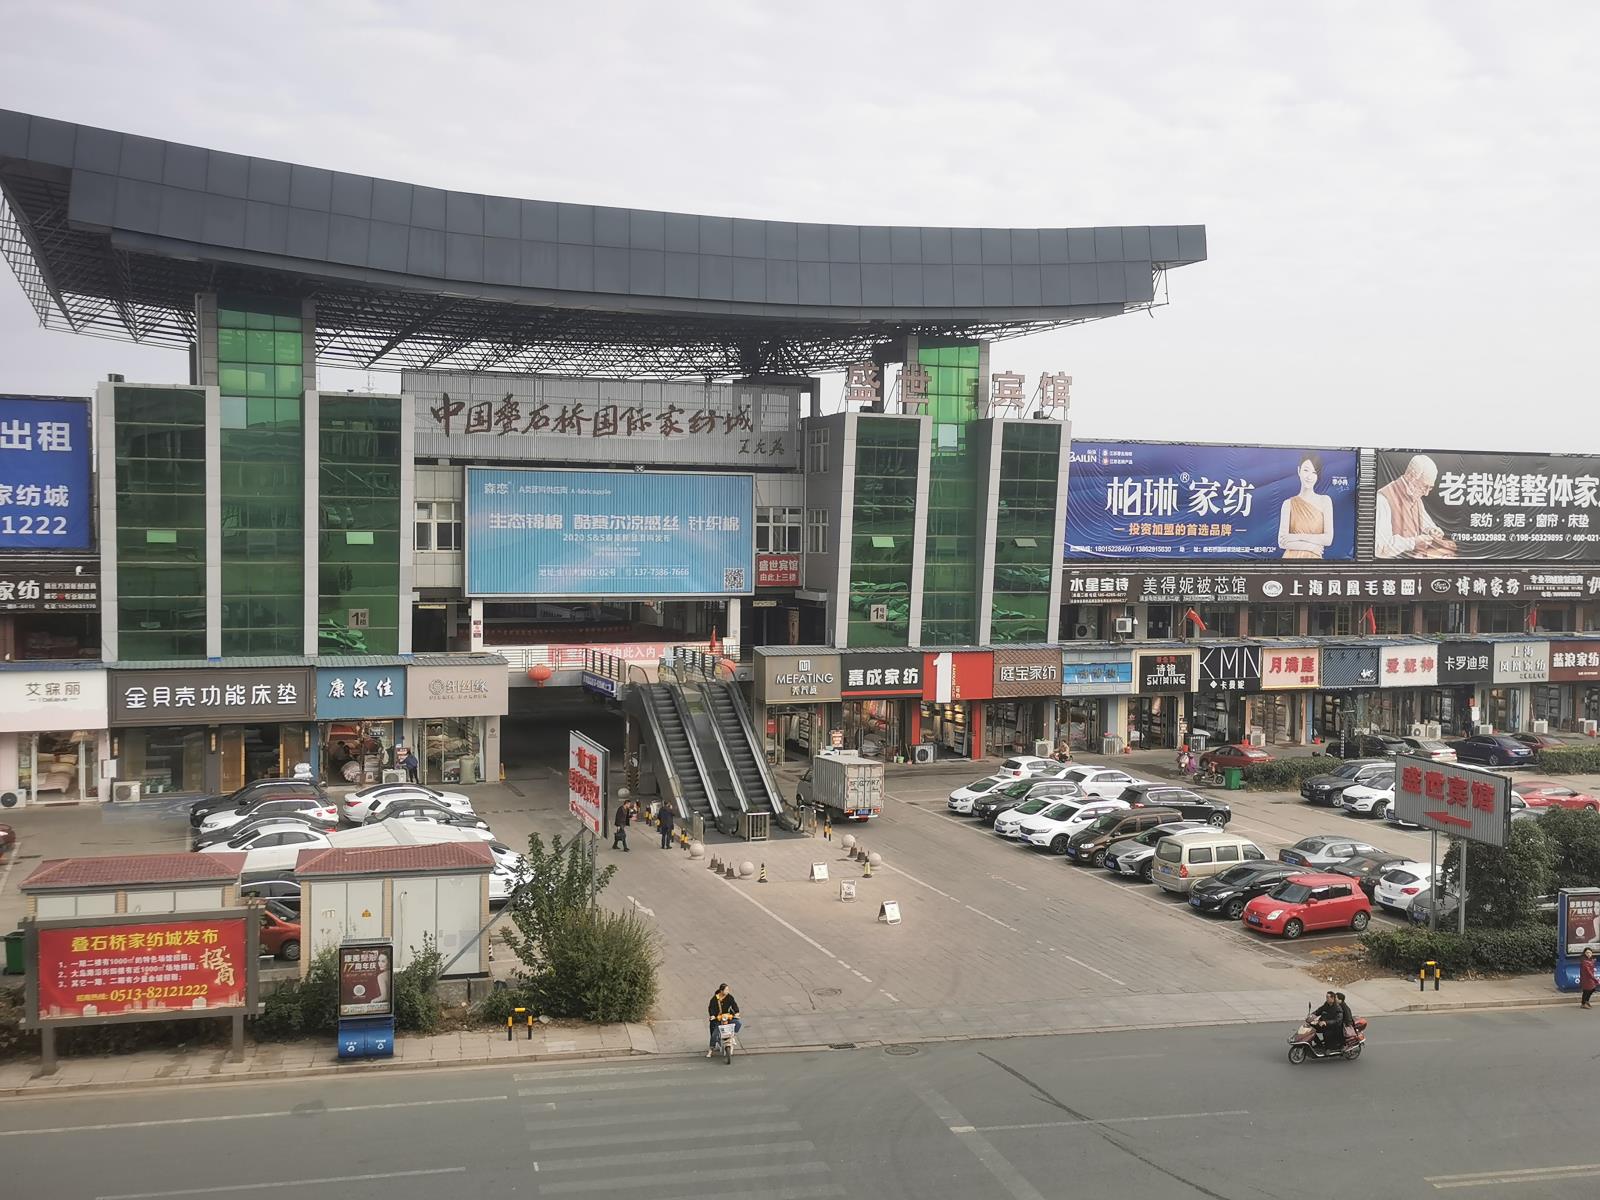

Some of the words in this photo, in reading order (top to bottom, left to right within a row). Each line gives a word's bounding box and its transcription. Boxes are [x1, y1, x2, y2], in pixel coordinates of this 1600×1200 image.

[846, 361, 1073, 411] 盛世宾馆
[0, 419, 72, 451] 出租
[0, 484, 69, 507] 家纺城
[1438, 472, 1600, 508] 老裁缝整体家
[1128, 524, 1232, 537] 投资加盟的首选品牌
[759, 560, 799, 572] 盛世宾馆
[0, 580, 40, 599] 家纺
[1070, 578, 1129, 591] 水星宝诗
[1143, 577, 1247, 594] 美得妮被芯馆
[1200, 647, 1261, 679] KMN
[776, 673, 834, 684] MEFATING
[848, 668, 918, 686] 嘉成家纺
[1000, 665, 1057, 682] 庭宝家纺
[328, 677, 394, 698] 康尔佳
[1402, 766, 1496, 814] 盛世宾馆
[71, 929, 219, 953] 叠石桥家纺城发布
[110, 984, 208, 1001] 0513-82121222
